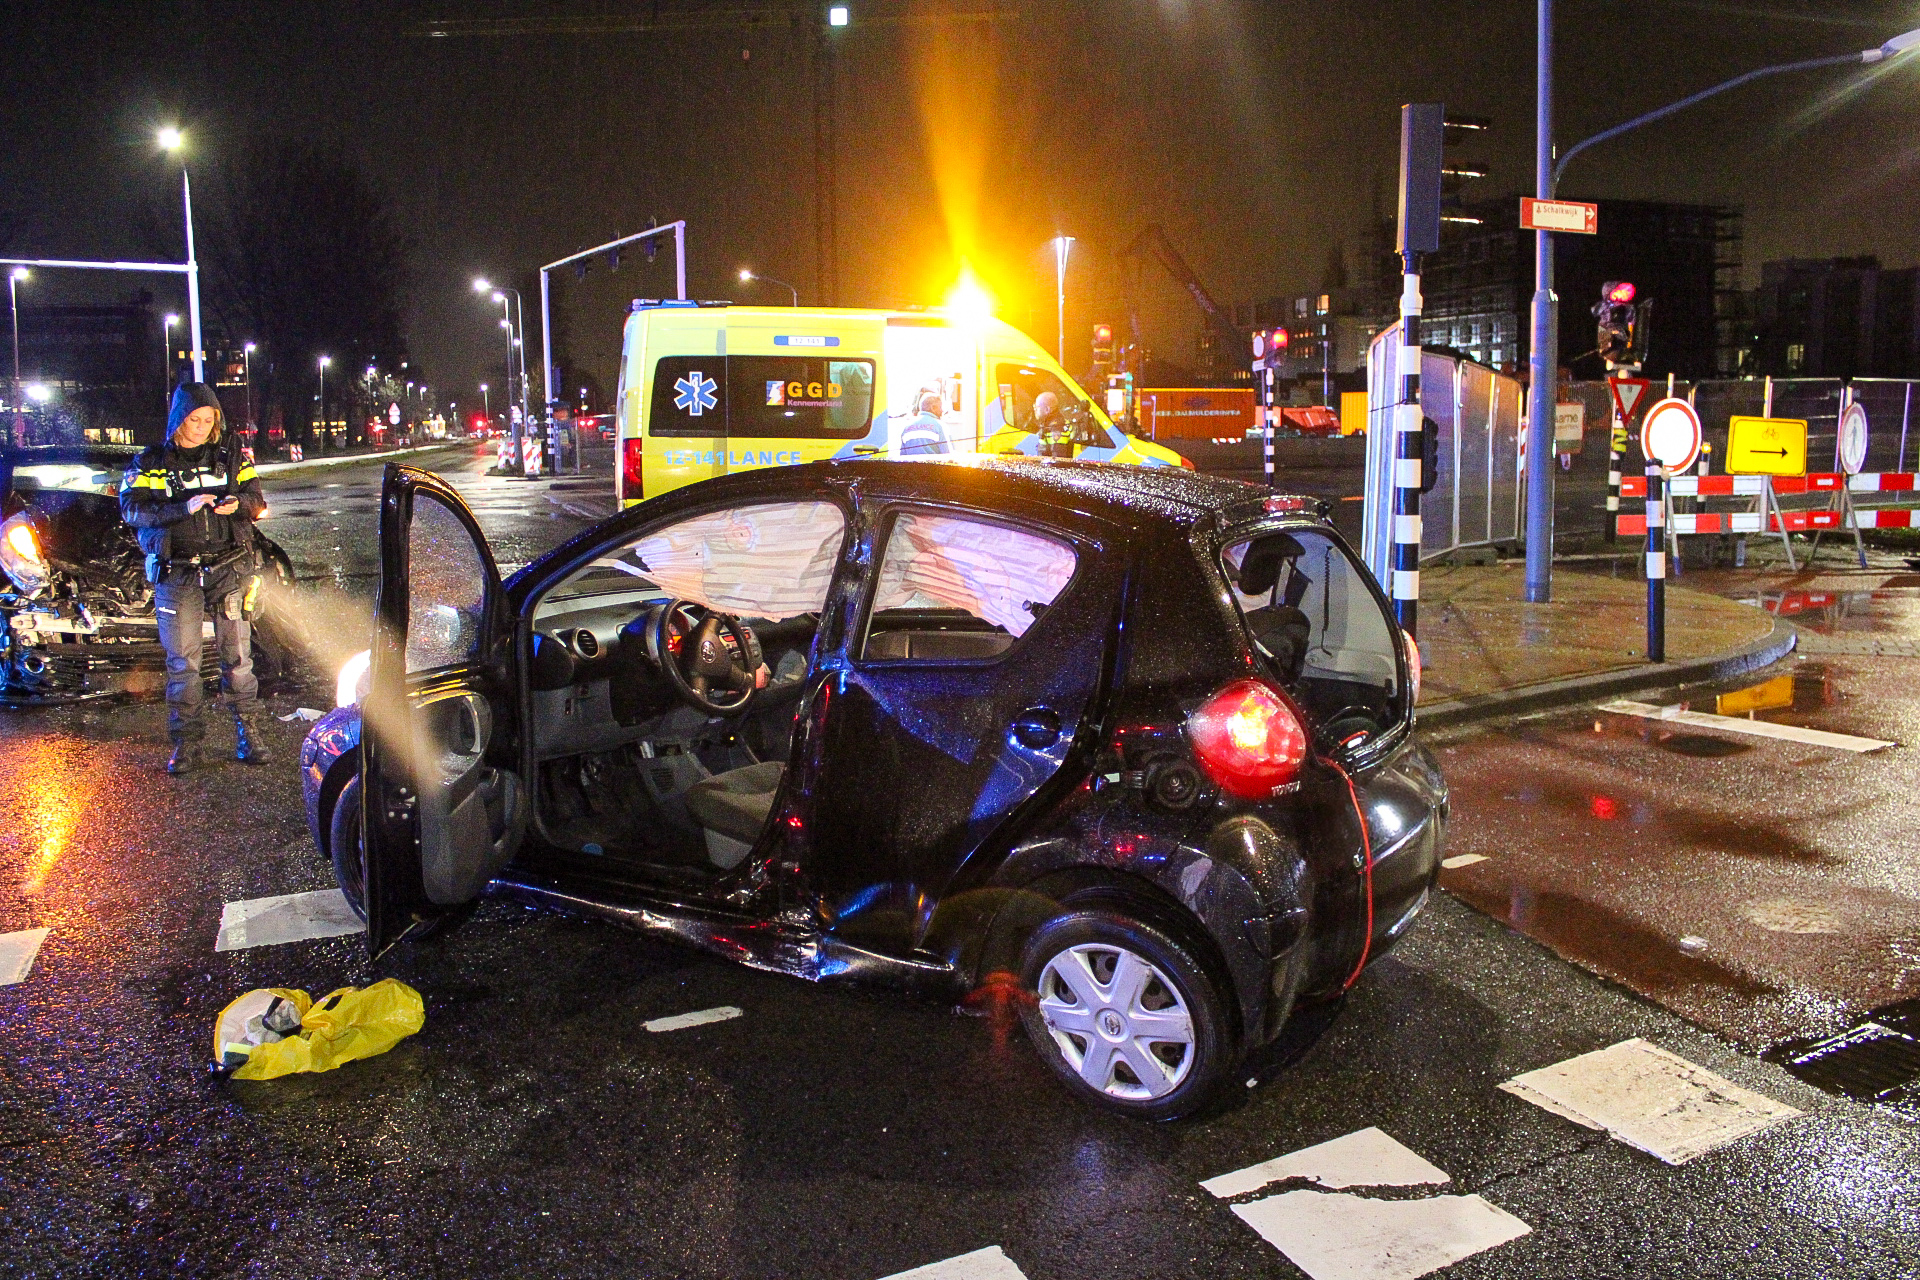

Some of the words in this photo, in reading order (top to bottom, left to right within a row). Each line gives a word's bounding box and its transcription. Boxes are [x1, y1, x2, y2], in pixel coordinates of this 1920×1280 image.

[1543, 205, 1578, 217] Schalkwijk
[787, 381, 843, 398] GGD
[787, 399, 843, 407] Kennemerland
[1271, 780, 1301, 797] TOYOTA
